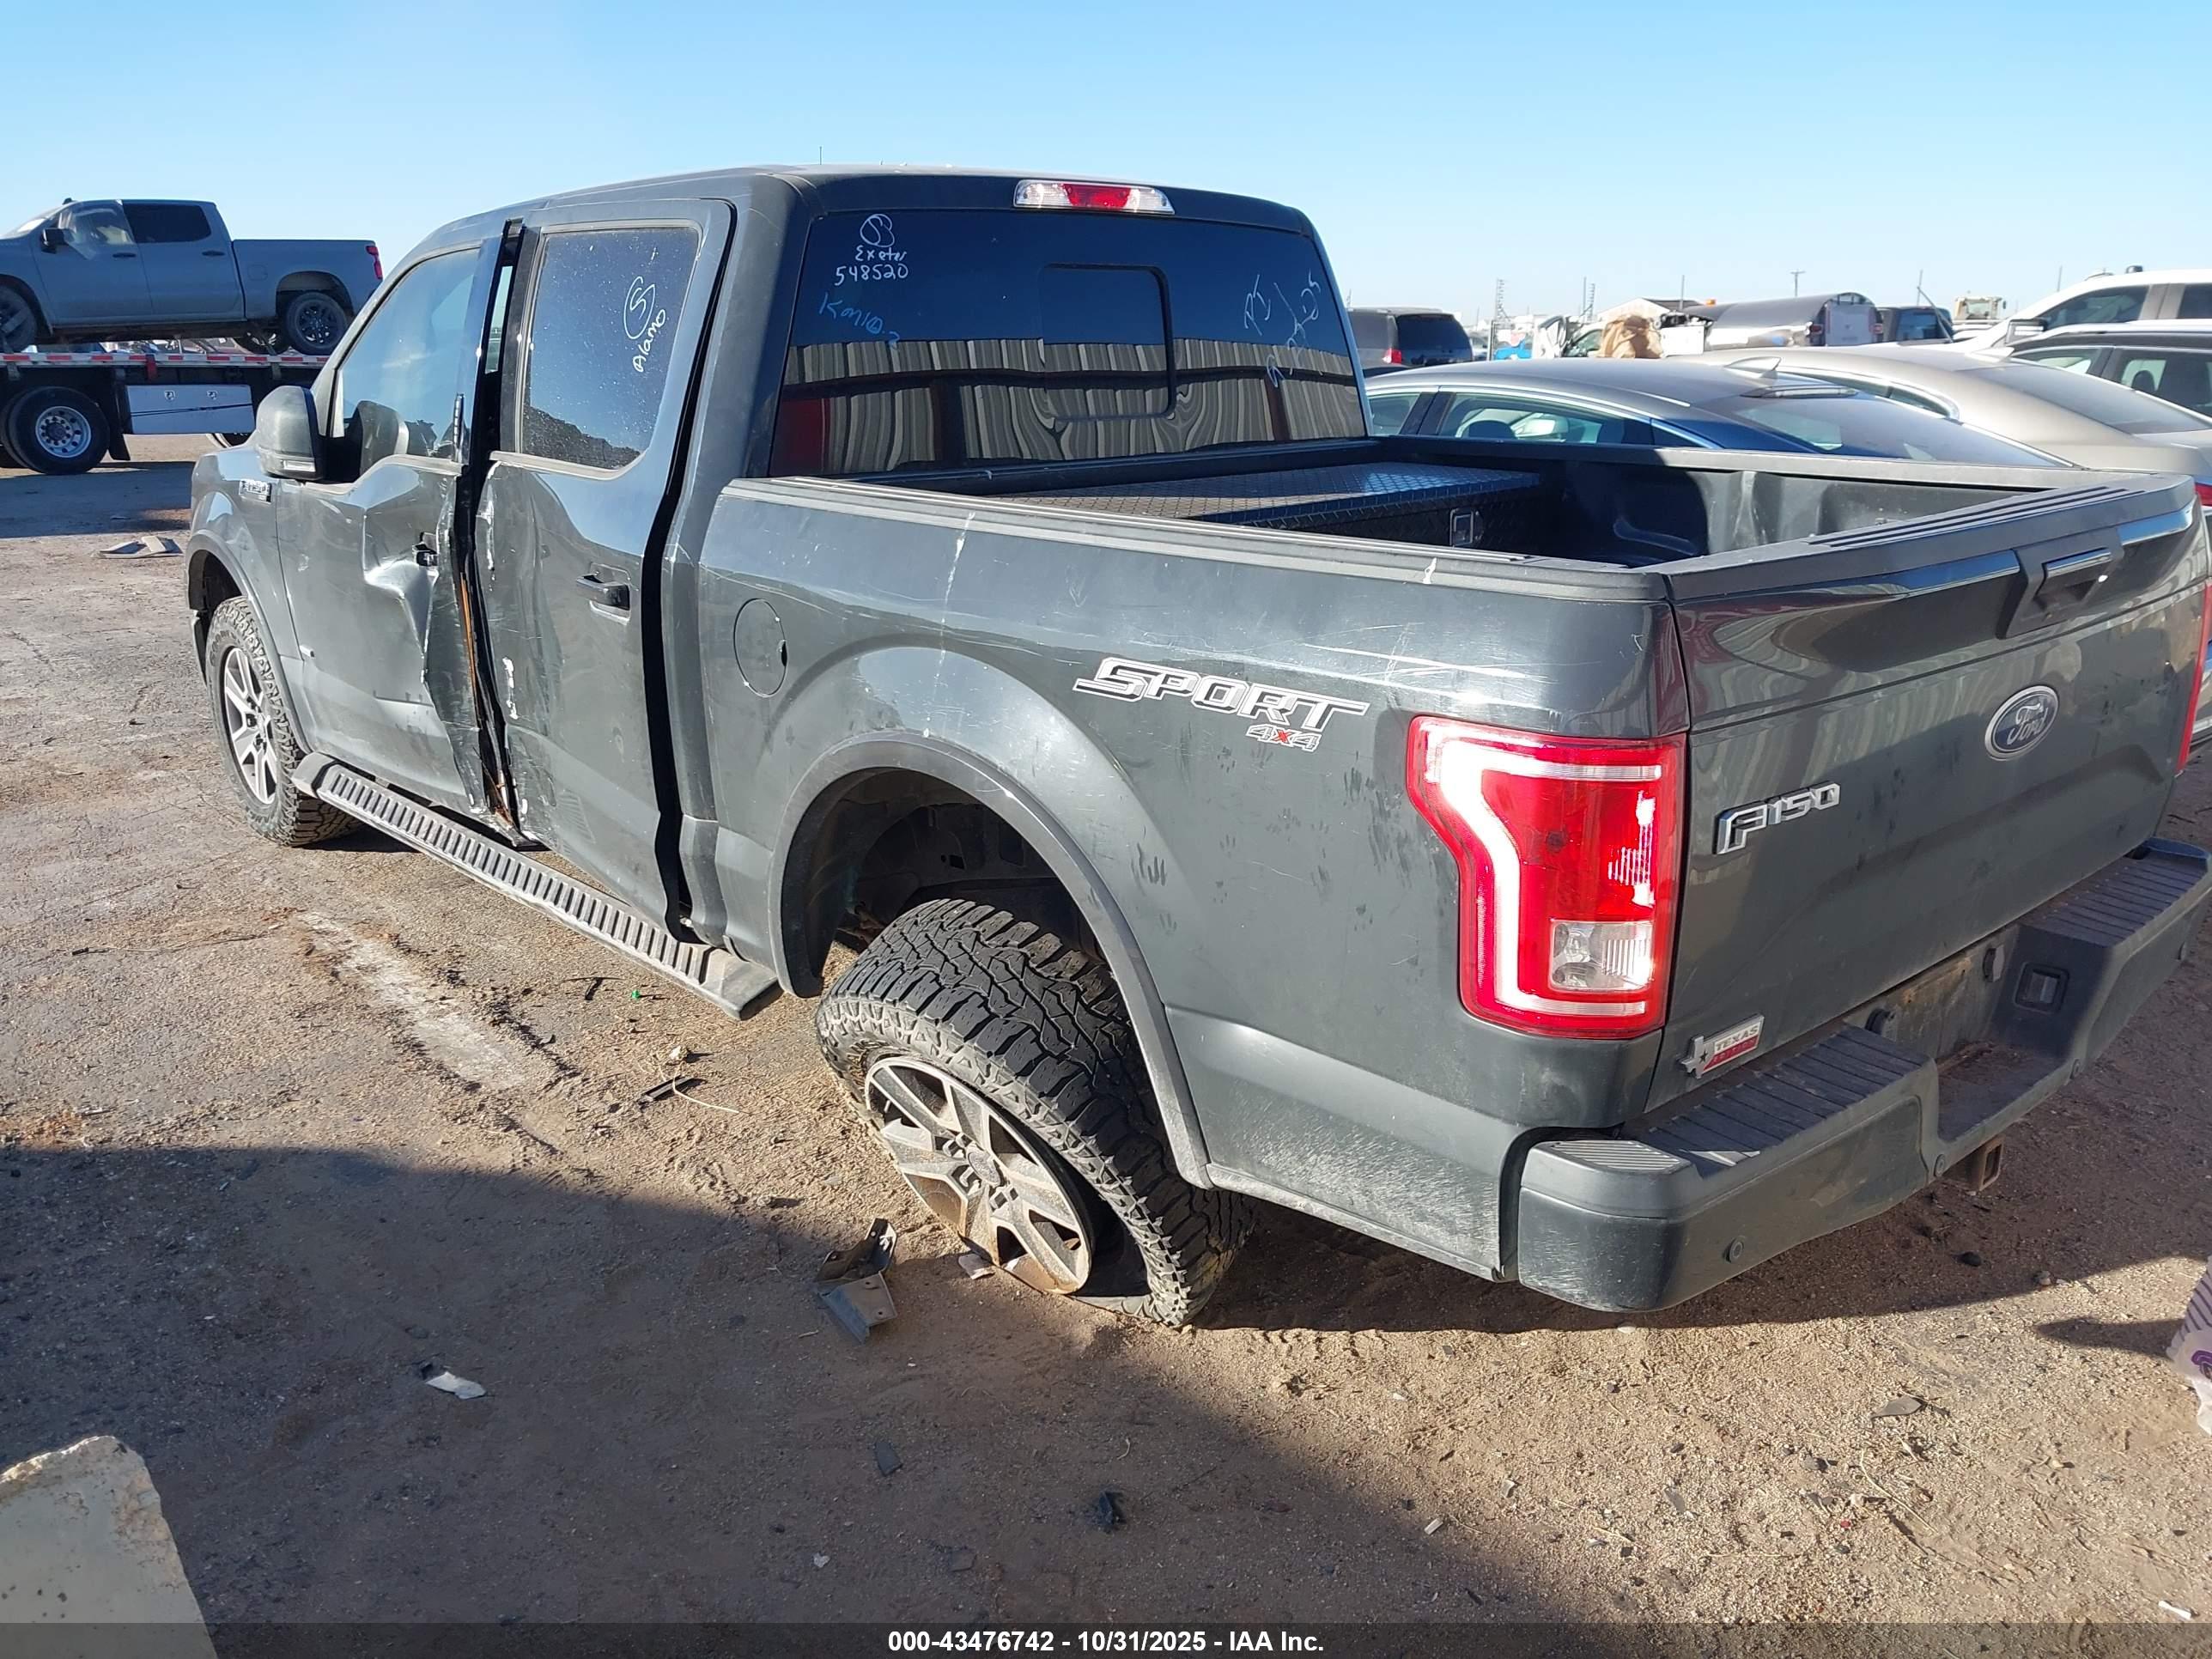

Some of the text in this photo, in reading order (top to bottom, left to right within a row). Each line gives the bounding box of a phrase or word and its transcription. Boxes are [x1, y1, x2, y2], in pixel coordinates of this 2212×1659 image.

[834, 263, 908, 286] 548520
[632, 309, 666, 373] Alamo
[1073, 656, 1370, 733] SPORT
[2007, 702, 2049, 745] Ford
[1715, 782, 1841, 854] F150
[1717, 1024, 1759, 1051] TEXAS
